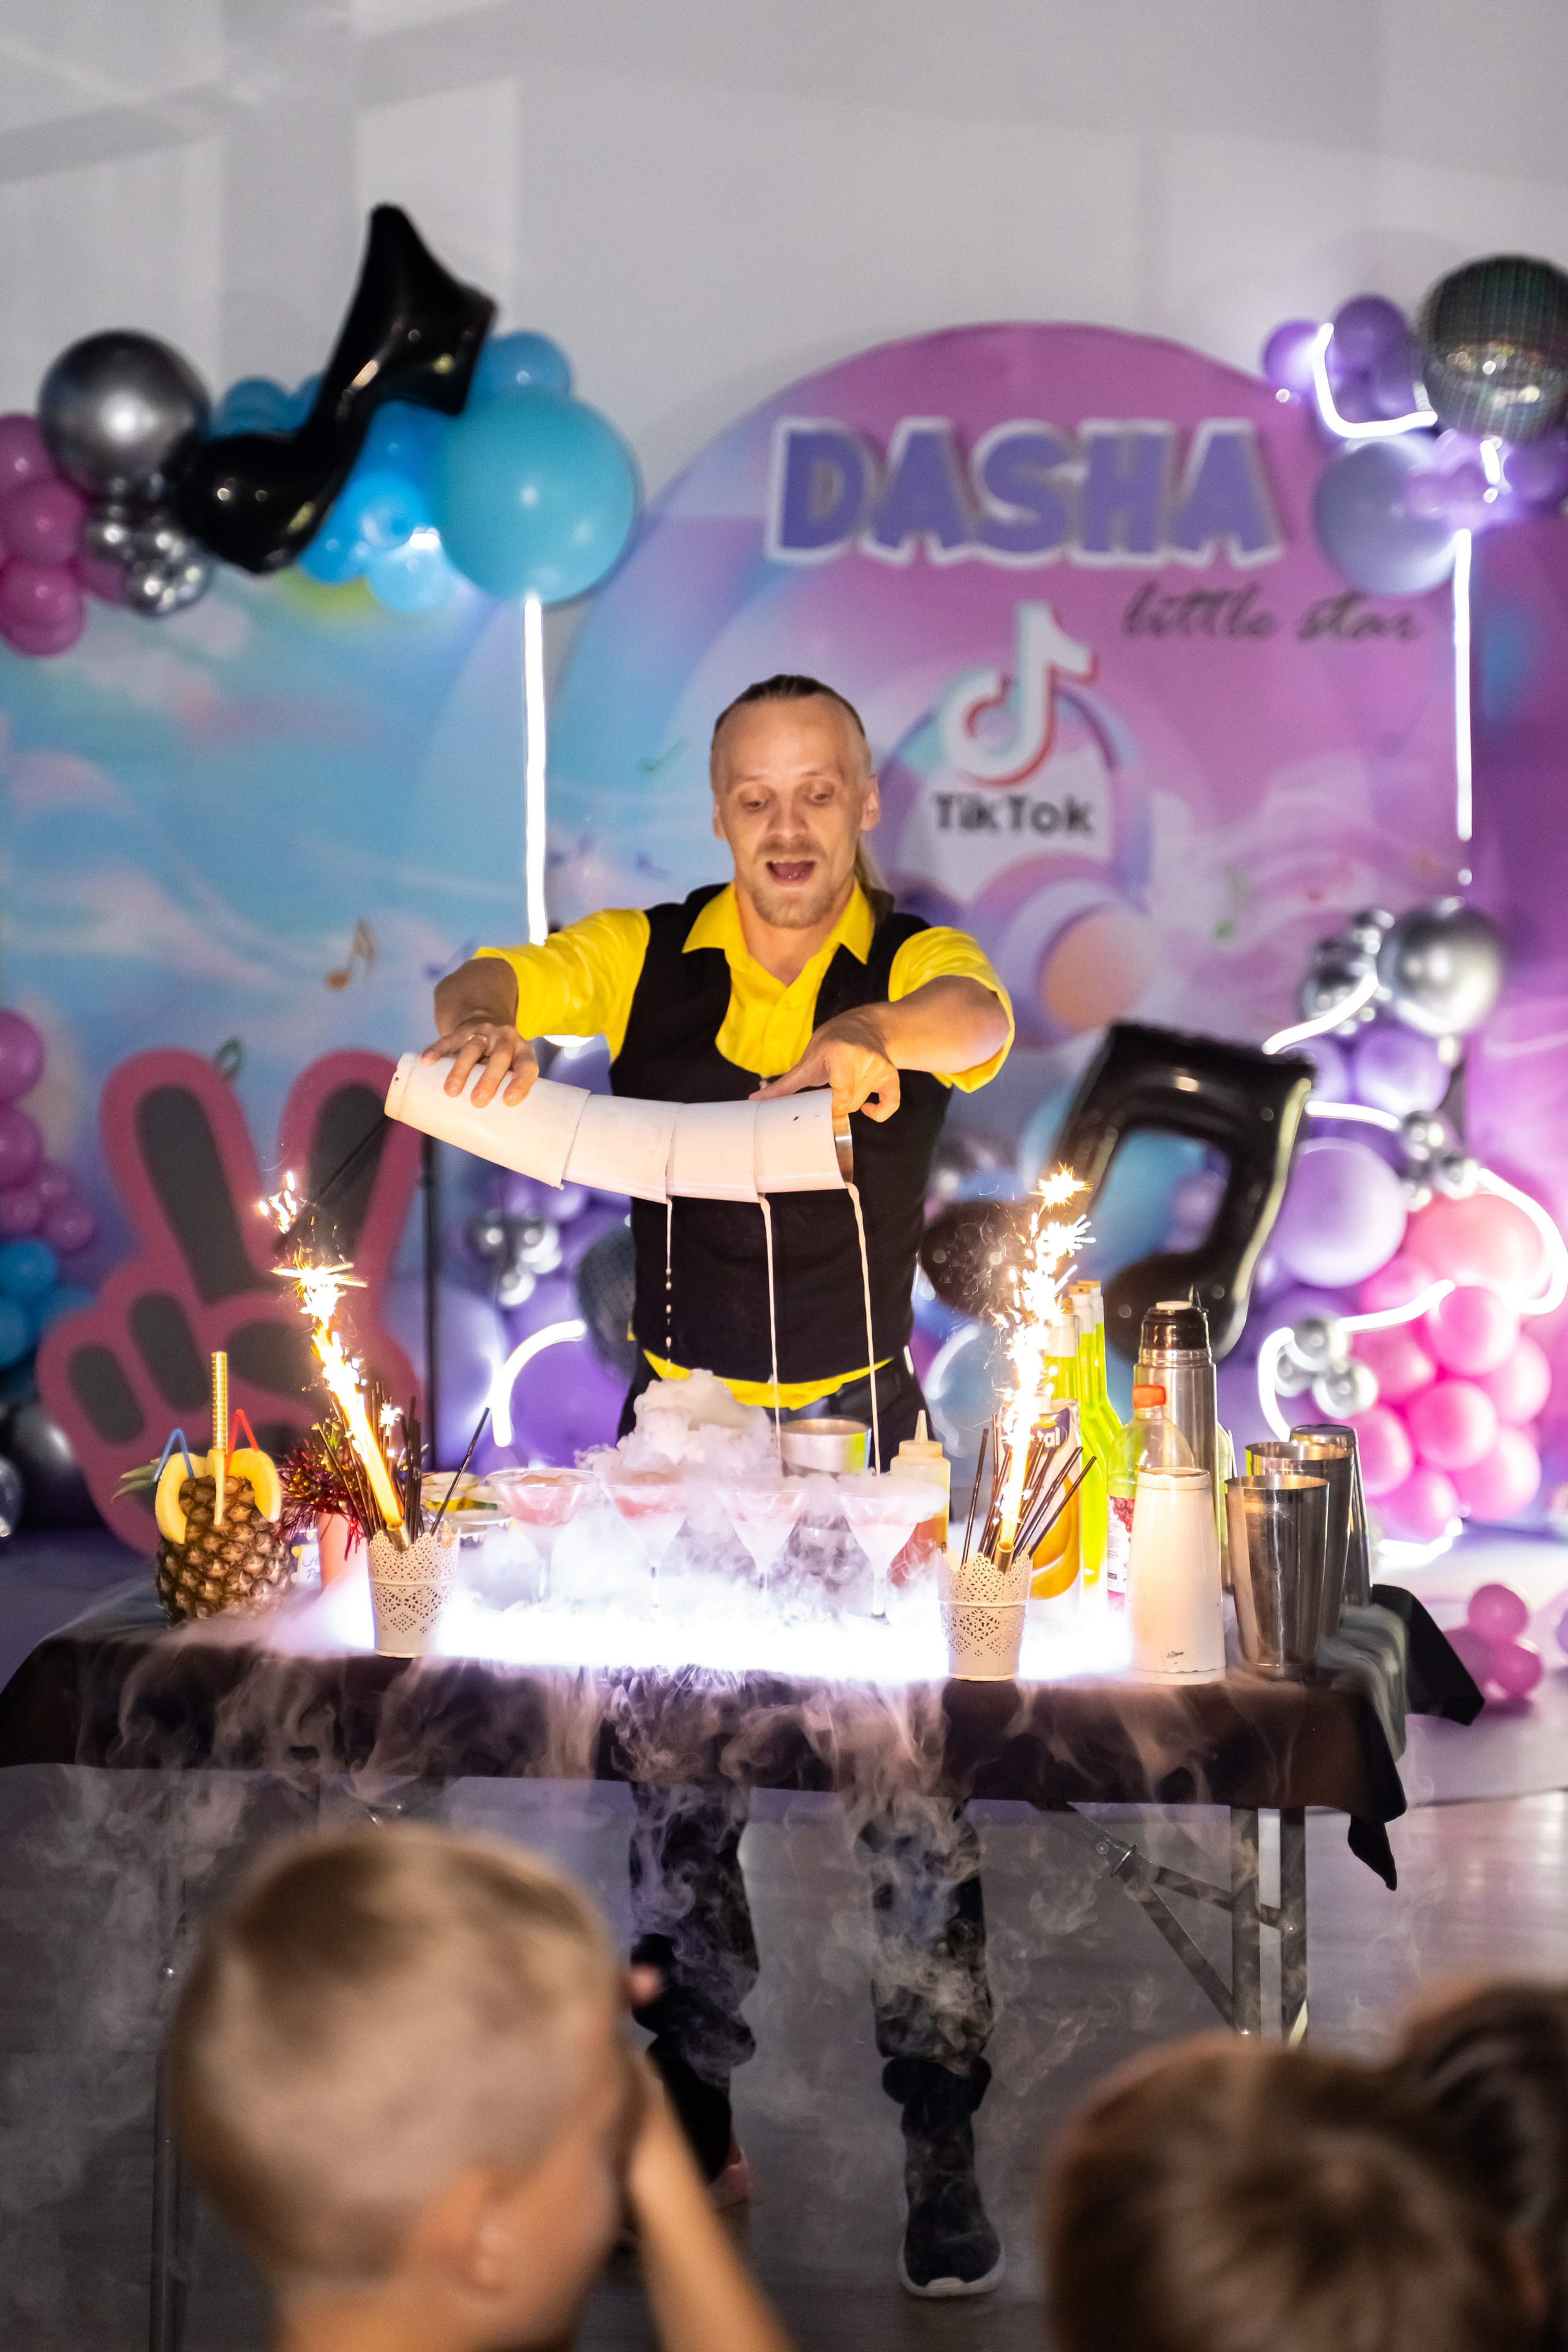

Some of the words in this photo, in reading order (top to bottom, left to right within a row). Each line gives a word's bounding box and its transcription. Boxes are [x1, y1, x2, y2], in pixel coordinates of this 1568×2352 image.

[768, 418, 1284, 567] DASHA
[1122, 579, 1276, 637] little
[1297, 591, 1417, 642] star
[932, 790, 1095, 835] TikTok
